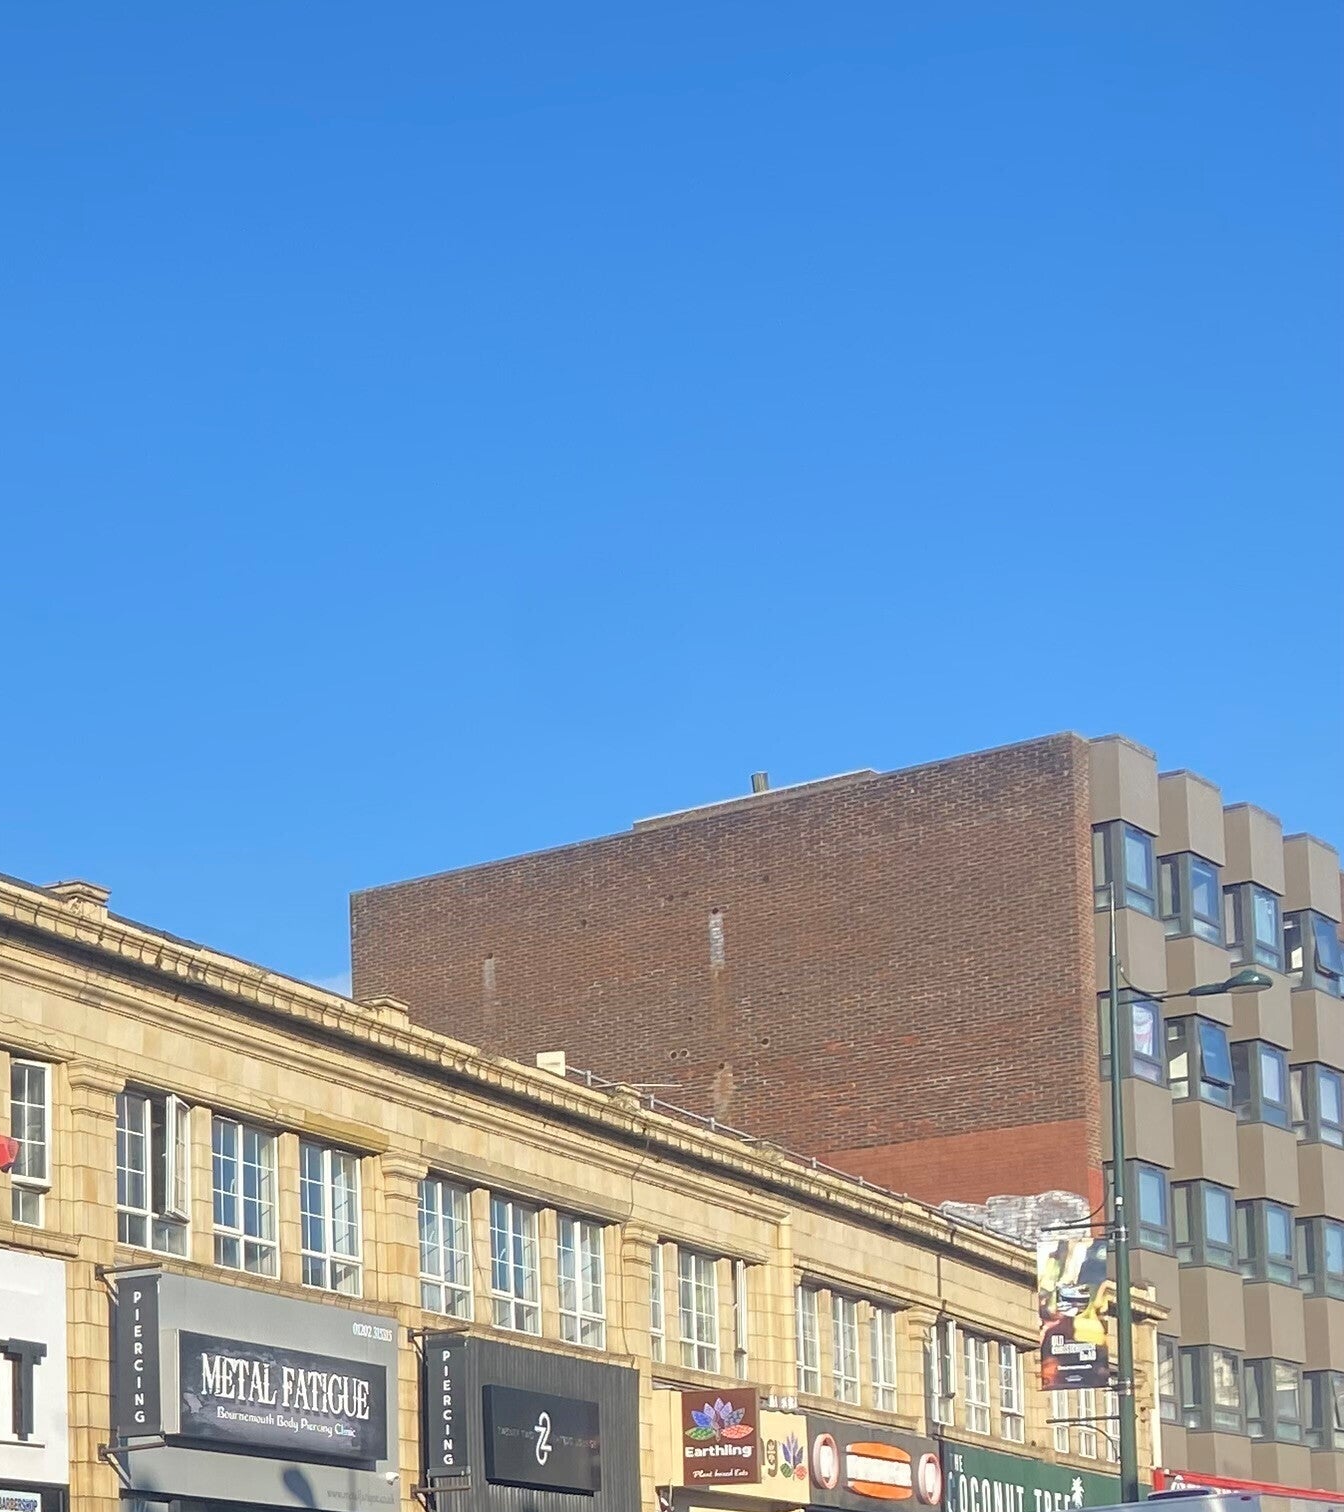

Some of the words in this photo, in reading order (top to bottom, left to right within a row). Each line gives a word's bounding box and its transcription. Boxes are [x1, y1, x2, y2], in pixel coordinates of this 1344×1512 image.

[133, 1291, 146, 1424] PIERCING
[201, 1352, 277, 1406] METAL
[281, 1365, 370, 1420] FATIGUE
[216, 1406, 275, 1427] Bournemouth
[276, 1415, 299, 1434] Body
[442, 1350, 454, 1466] PIERCING
[685, 1444, 753, 1458] Earthling
